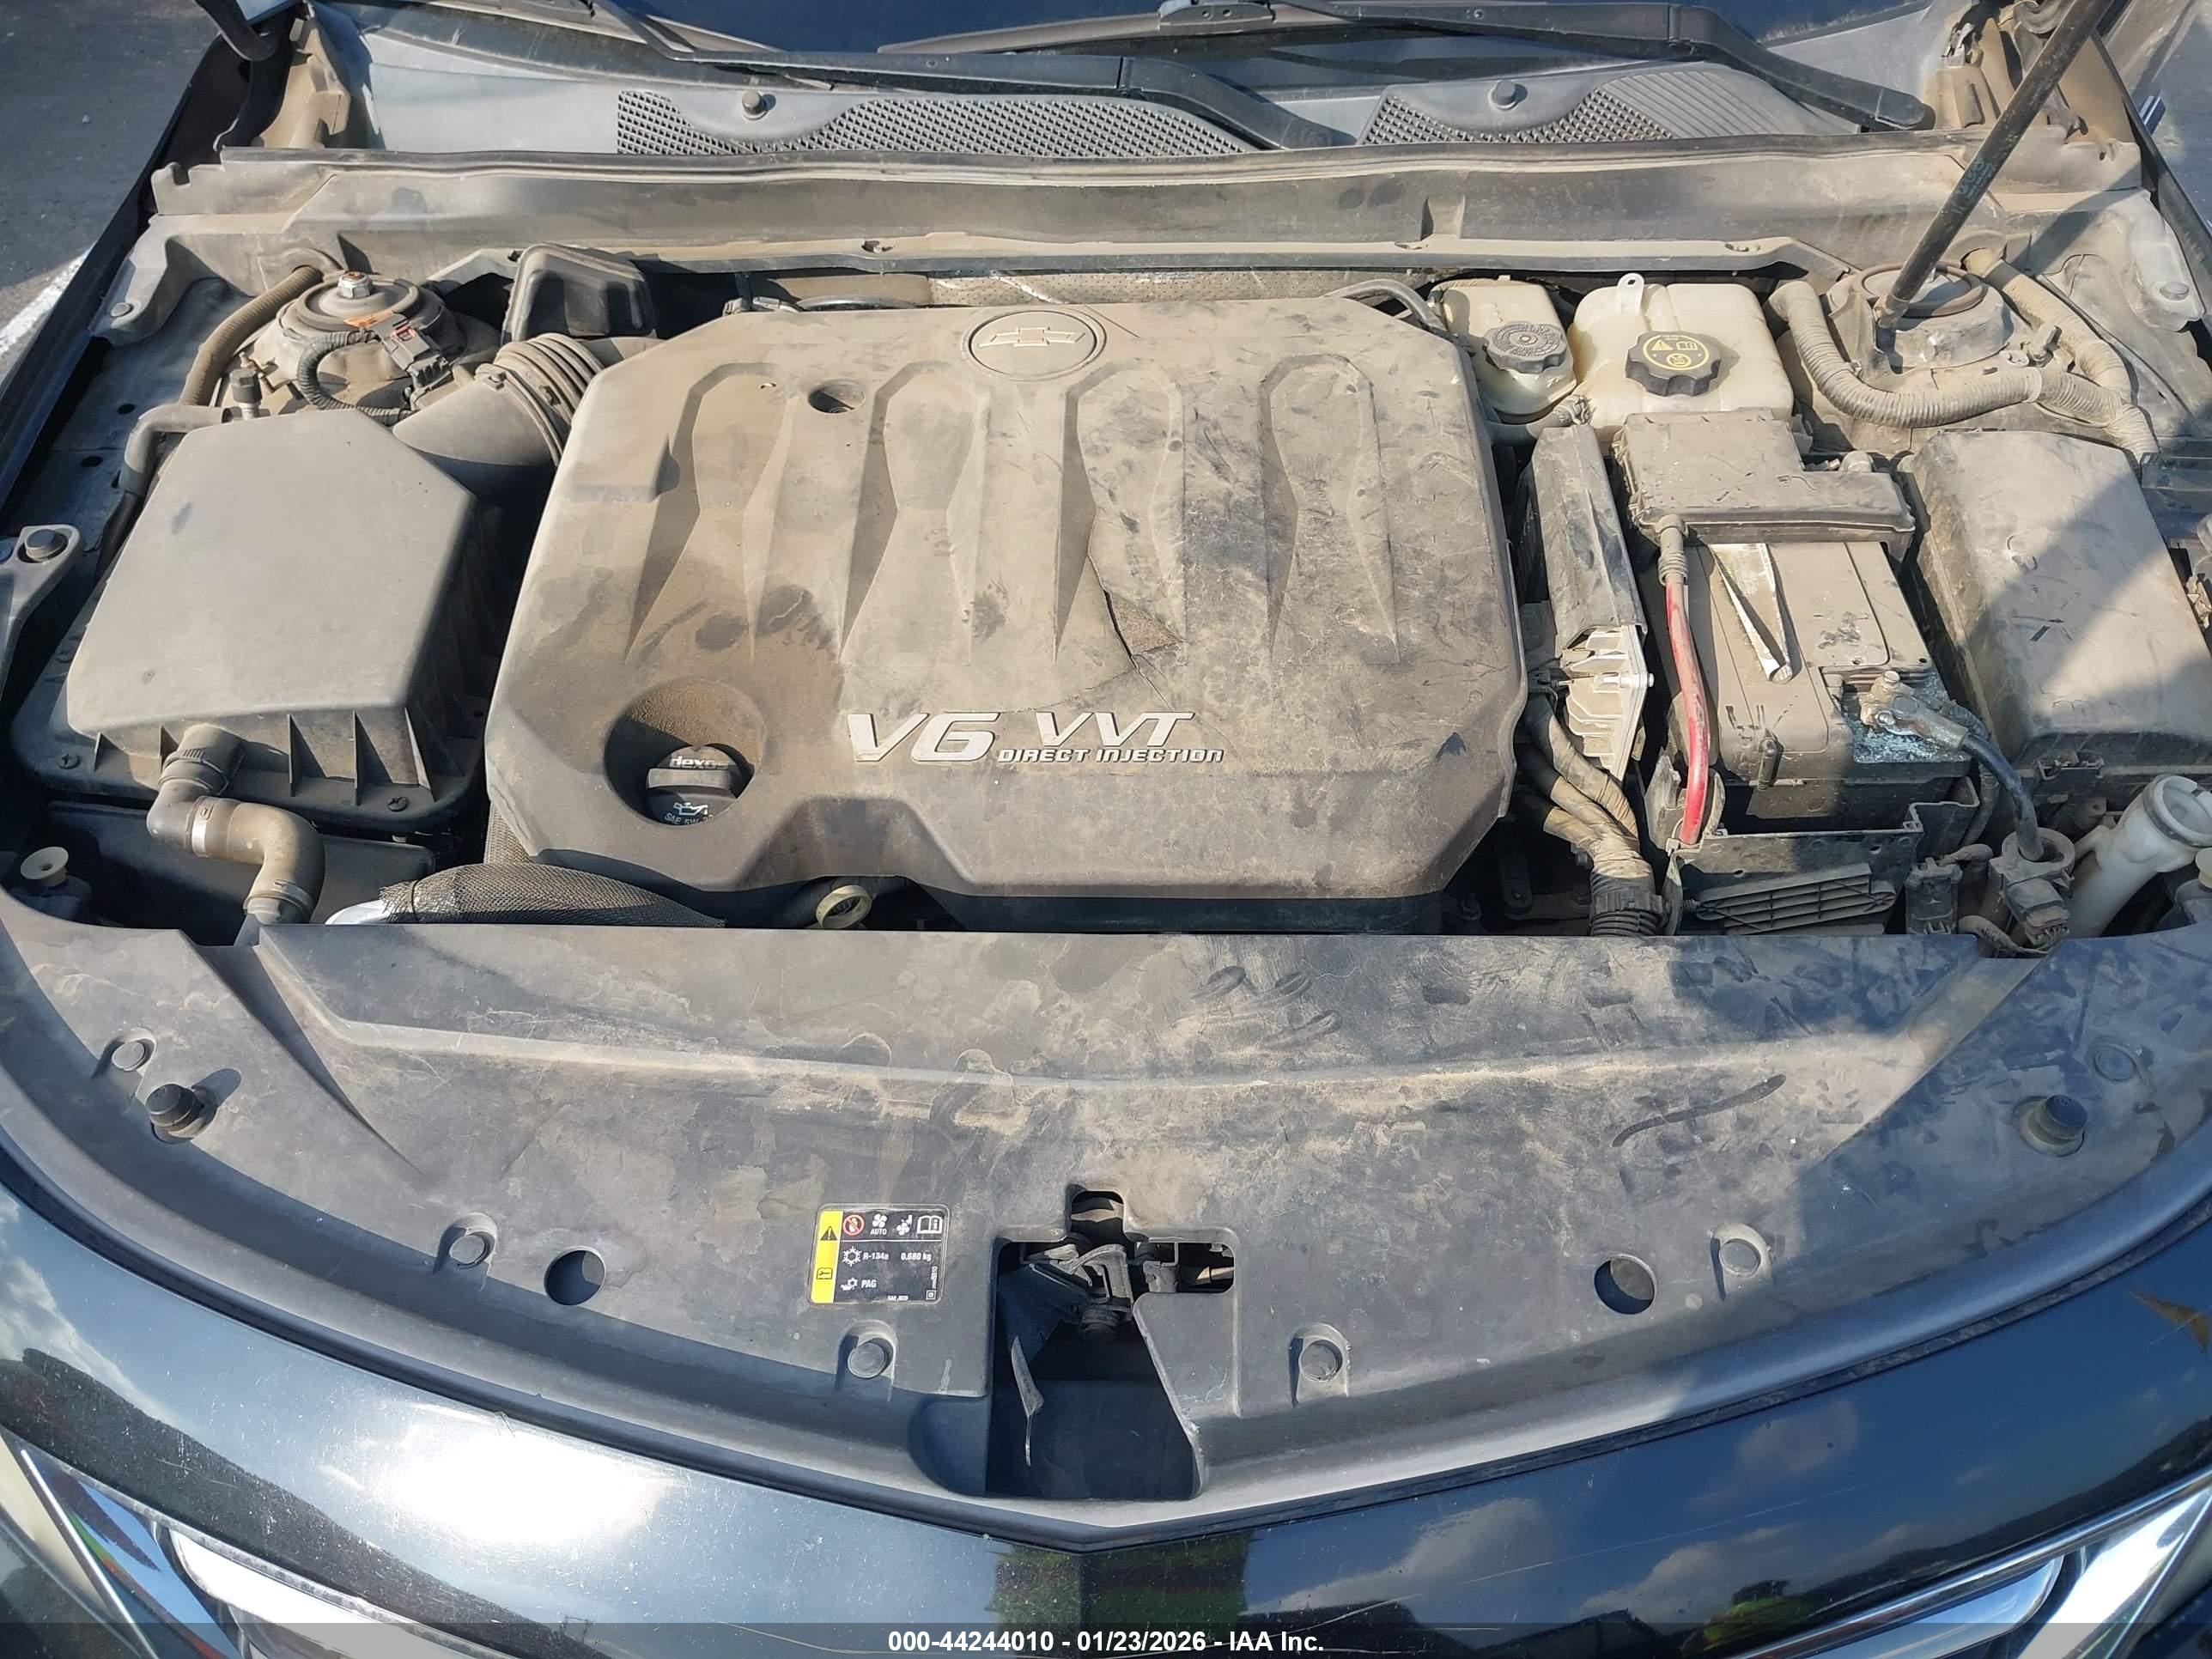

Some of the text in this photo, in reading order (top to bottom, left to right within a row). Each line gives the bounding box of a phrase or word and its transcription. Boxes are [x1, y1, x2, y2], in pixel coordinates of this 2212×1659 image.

[848, 712, 1195, 763] V6 VVT
[998, 749, 1224, 763] DIRECT INJECTION
[670, 756, 728, 769] dexos
[665, 812, 681, 824] SAE
[862, 1252, 889, 1261] R-134a
[922, 1252, 932, 1261] kg
[861, 1279, 877, 1288] PAG
